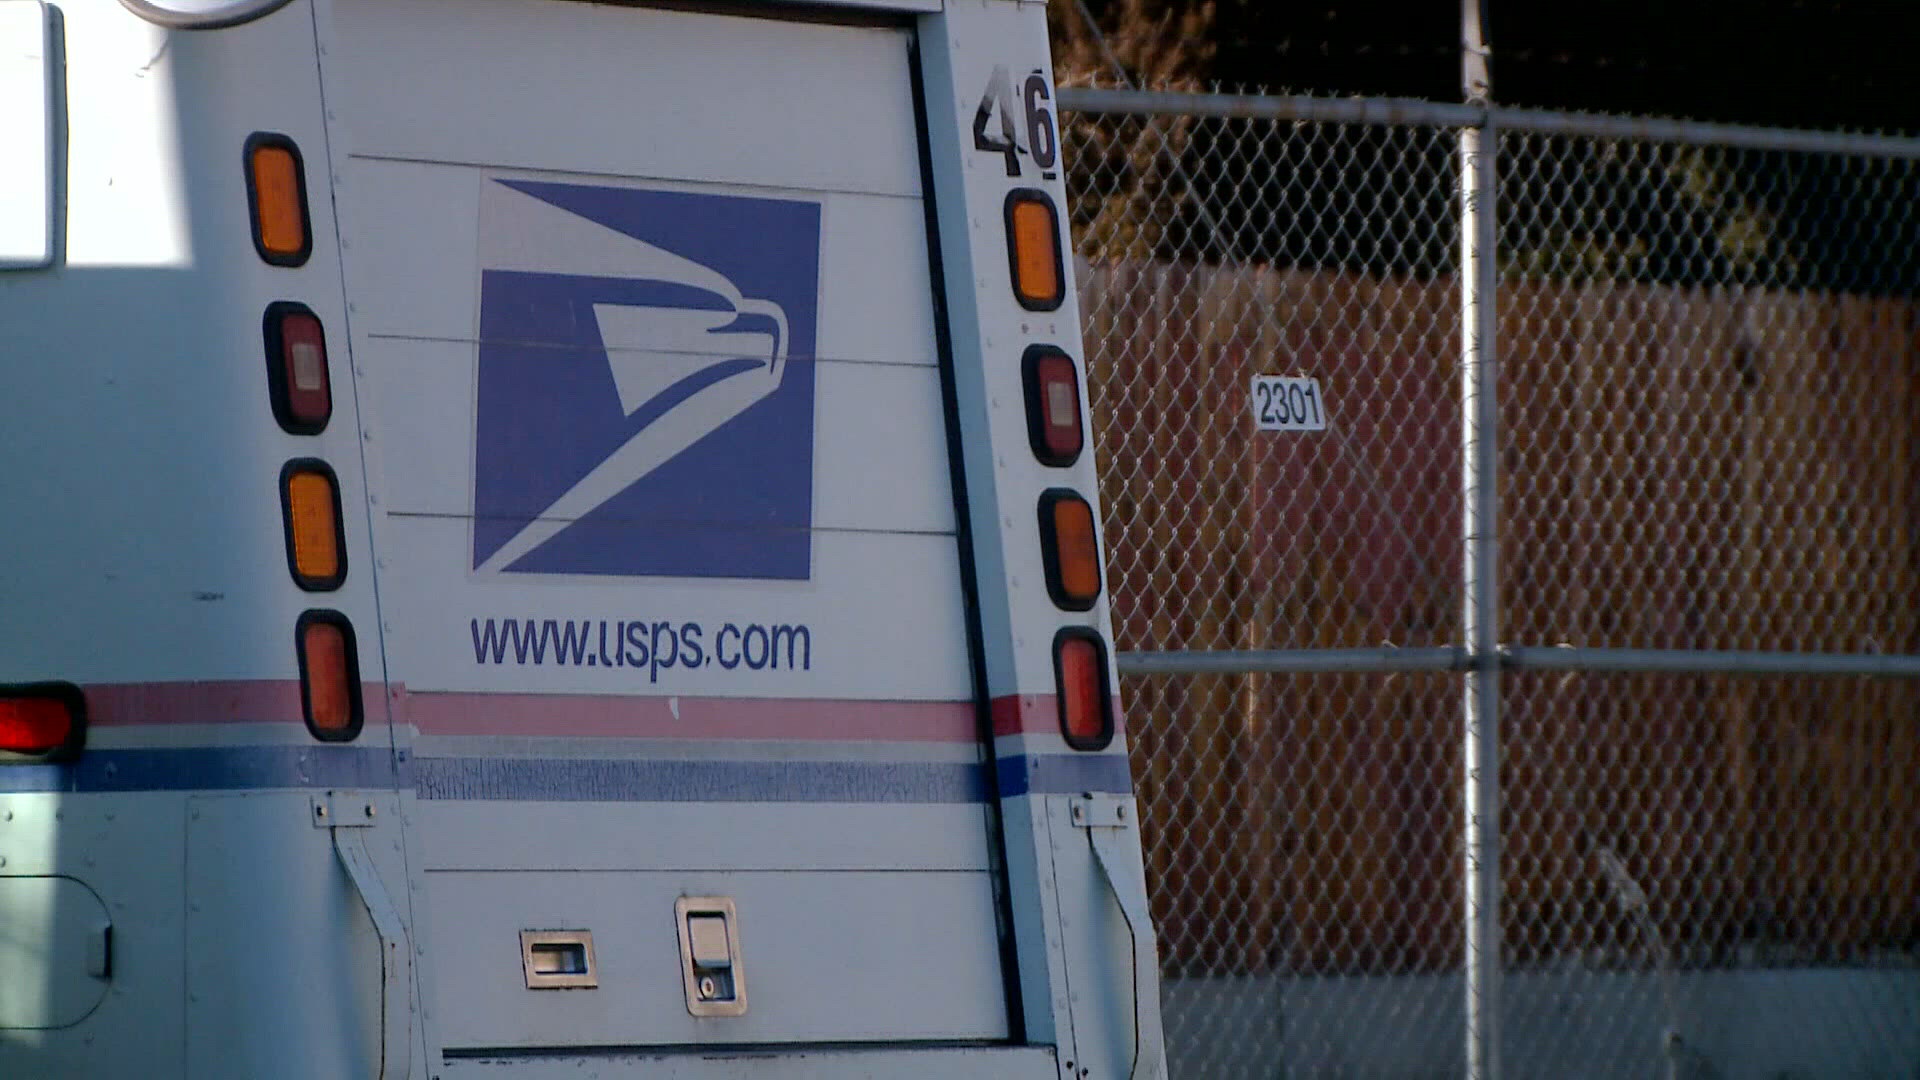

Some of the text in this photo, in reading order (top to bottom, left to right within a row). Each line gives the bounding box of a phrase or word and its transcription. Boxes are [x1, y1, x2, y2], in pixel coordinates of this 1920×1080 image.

[973, 65, 1056, 176] 46
[1257, 381, 1320, 424] 2301
[470, 617, 811, 684] www.usps.com
